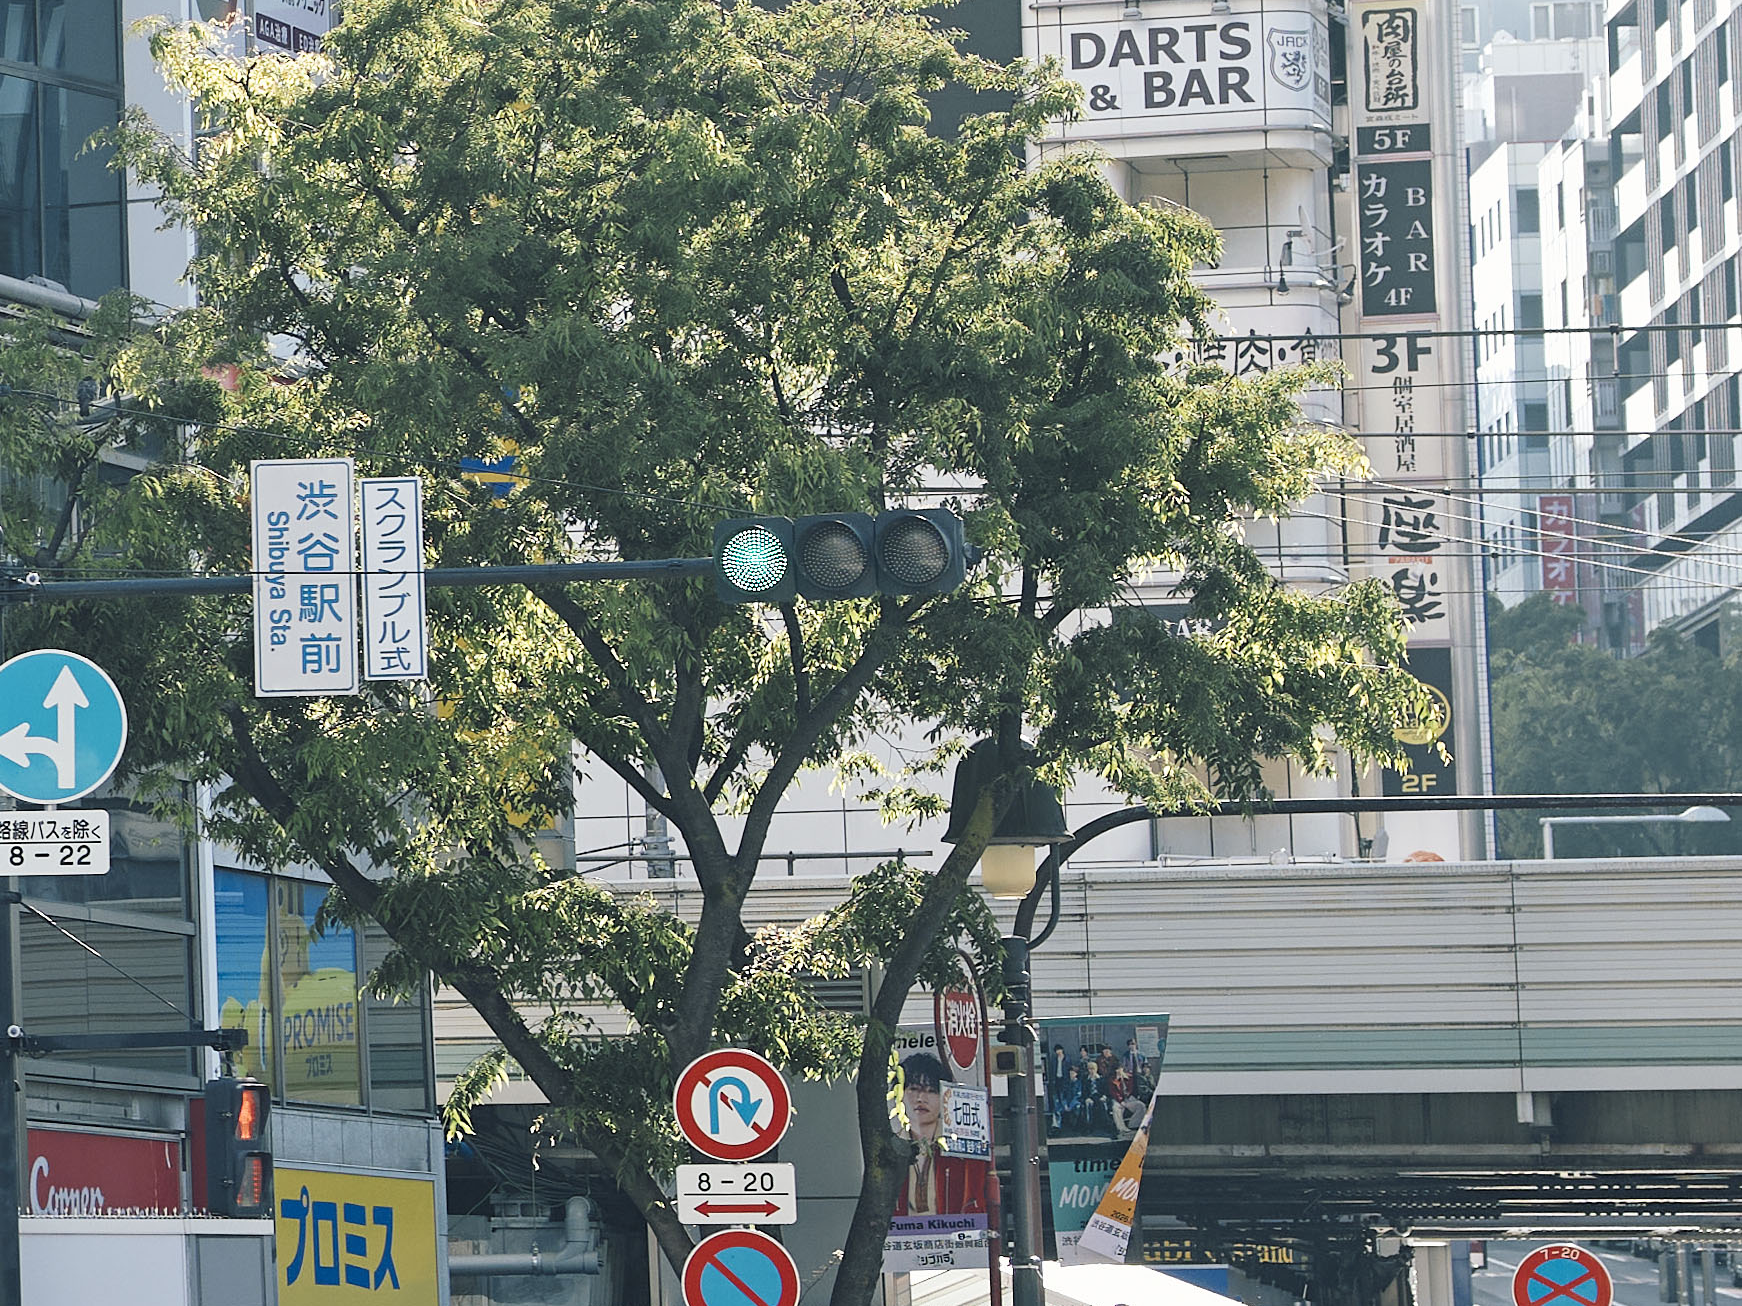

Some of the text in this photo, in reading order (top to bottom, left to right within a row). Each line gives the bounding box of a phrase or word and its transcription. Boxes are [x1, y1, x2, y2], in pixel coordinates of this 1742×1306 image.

[1070, 21, 1253, 72] DARTS
[1377, 14, 1411, 107] 肉屋の台所
[1089, 65, 1257, 113] & BAR
[1373, 129, 1411, 151] 5F
[1362, 173, 1392, 287] カラオケ
[1405, 187, 1431, 273] BAR
[1384, 288, 1413, 306] 4F
[1371, 329, 1432, 374] 3F
[1392, 376, 1417, 472] 個室居酒屋
[267, 511, 291, 652] Shibuya Sta.
[296, 480, 343, 675] 渋谷駅前
[375, 486, 411, 673] スクランブル式
[1401, 774, 1436, 793] 2F
[284, 1001, 354, 1054] PROMISE
[947, 1000, 978, 1039] 消火栓
[280, 1184, 402, 1292] プロミス
[889, 1218, 975, 1231] Fuma Kikuchi
[1540, 1247, 1582, 1262] 7-20
